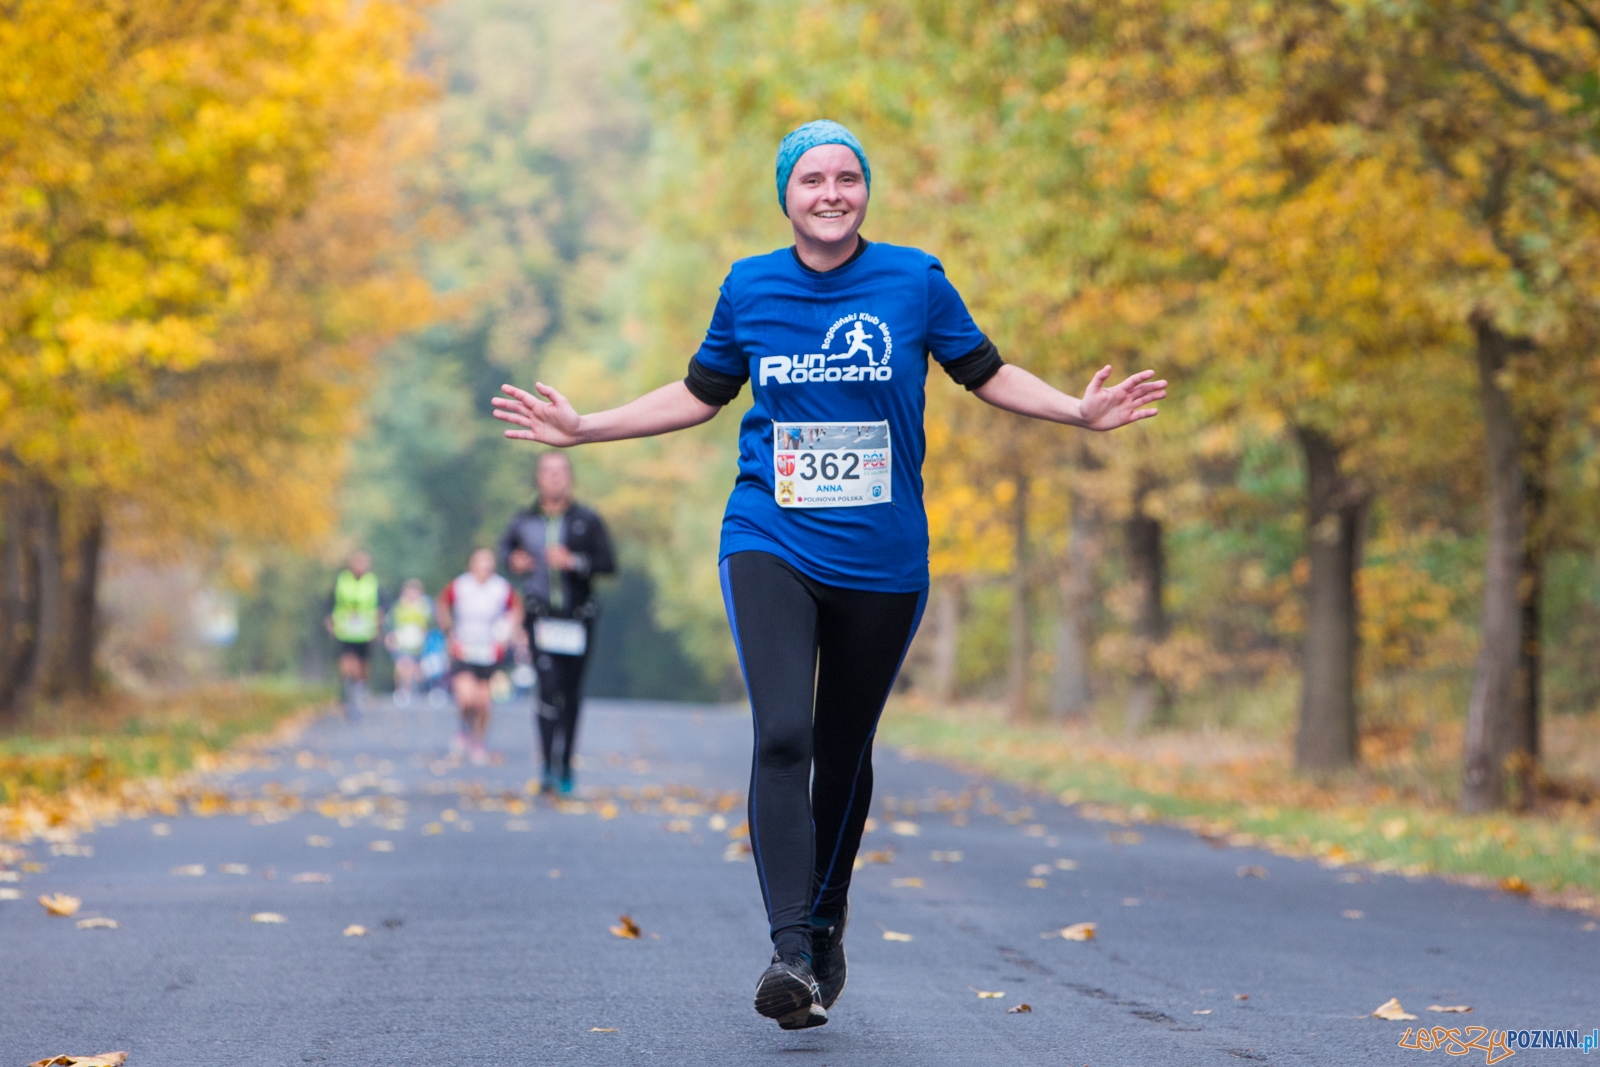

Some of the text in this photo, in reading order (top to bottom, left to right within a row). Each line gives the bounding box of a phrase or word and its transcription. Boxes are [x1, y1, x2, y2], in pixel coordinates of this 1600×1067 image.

[859, 312, 880, 325] Klub
[799, 452, 860, 480] 362
[816, 484, 843, 492] ANNA
